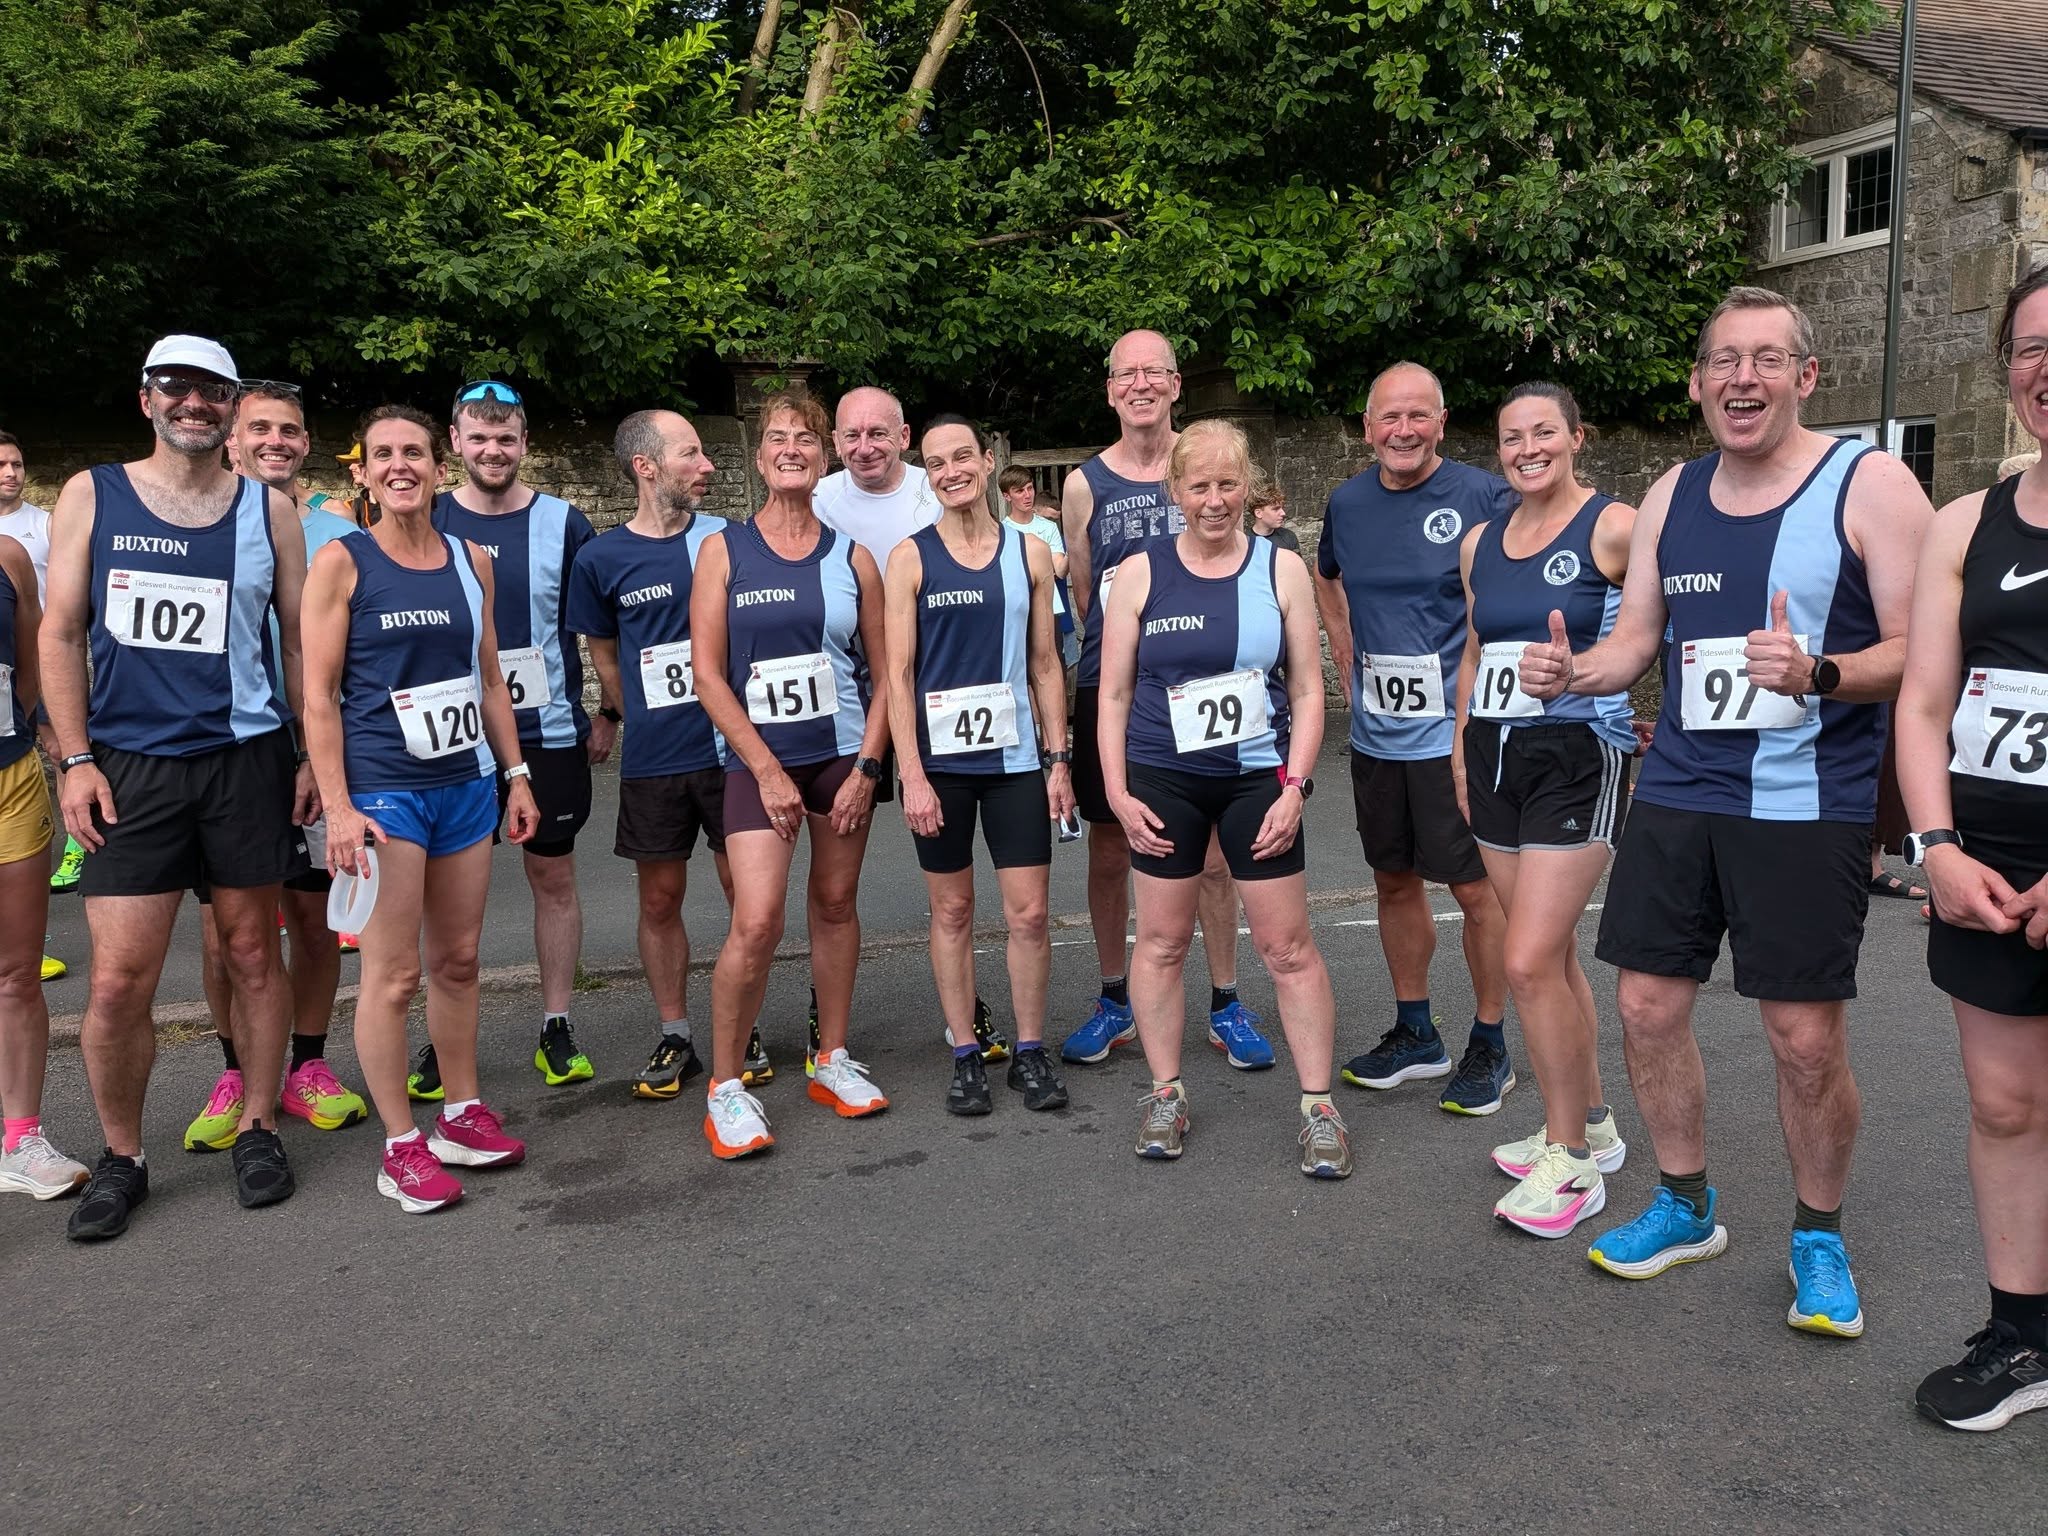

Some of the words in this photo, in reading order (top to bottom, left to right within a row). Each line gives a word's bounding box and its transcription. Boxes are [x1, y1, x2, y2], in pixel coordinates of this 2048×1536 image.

[1105, 494, 1157, 516] BUXTON
[1100, 505, 1187, 546] PETE
[112, 535, 189, 556] BUXTON
[113, 577, 128, 585] TRC
[135, 580, 167, 589] Tideswell
[168, 583, 197, 593] Running
[197, 586, 213, 594] Club
[620, 583, 673, 608] BUXTON
[736, 588, 795, 608] BUXTON
[927, 590, 983, 609] BUXTON
[132, 597, 206, 645] 102
[380, 610, 450, 629] BUXTON
[1145, 615, 1204, 636] BUXTON
[1700, 648, 1734, 657] Tideswell
[1394, 662, 1415, 670] Running
[416, 691, 445, 702] Tideswell
[445, 686, 469, 697] Running
[506, 670, 525, 704] 6
[1188, 684, 1214, 692] Tideswell
[1214, 678, 1239, 687] Running
[1375, 675, 1427, 712] 195
[1483, 667, 1516, 710] 19
[1705, 669, 1760, 721] 97
[1973, 681, 1985, 689] TRC
[1989, 681, 2029, 694] Tideswell
[766, 676, 820, 716] 151
[423, 701, 479, 752] 120
[954, 707, 994, 746] 42
[1198, 694, 1242, 741] 29
[1982, 706, 2048, 774] 73
